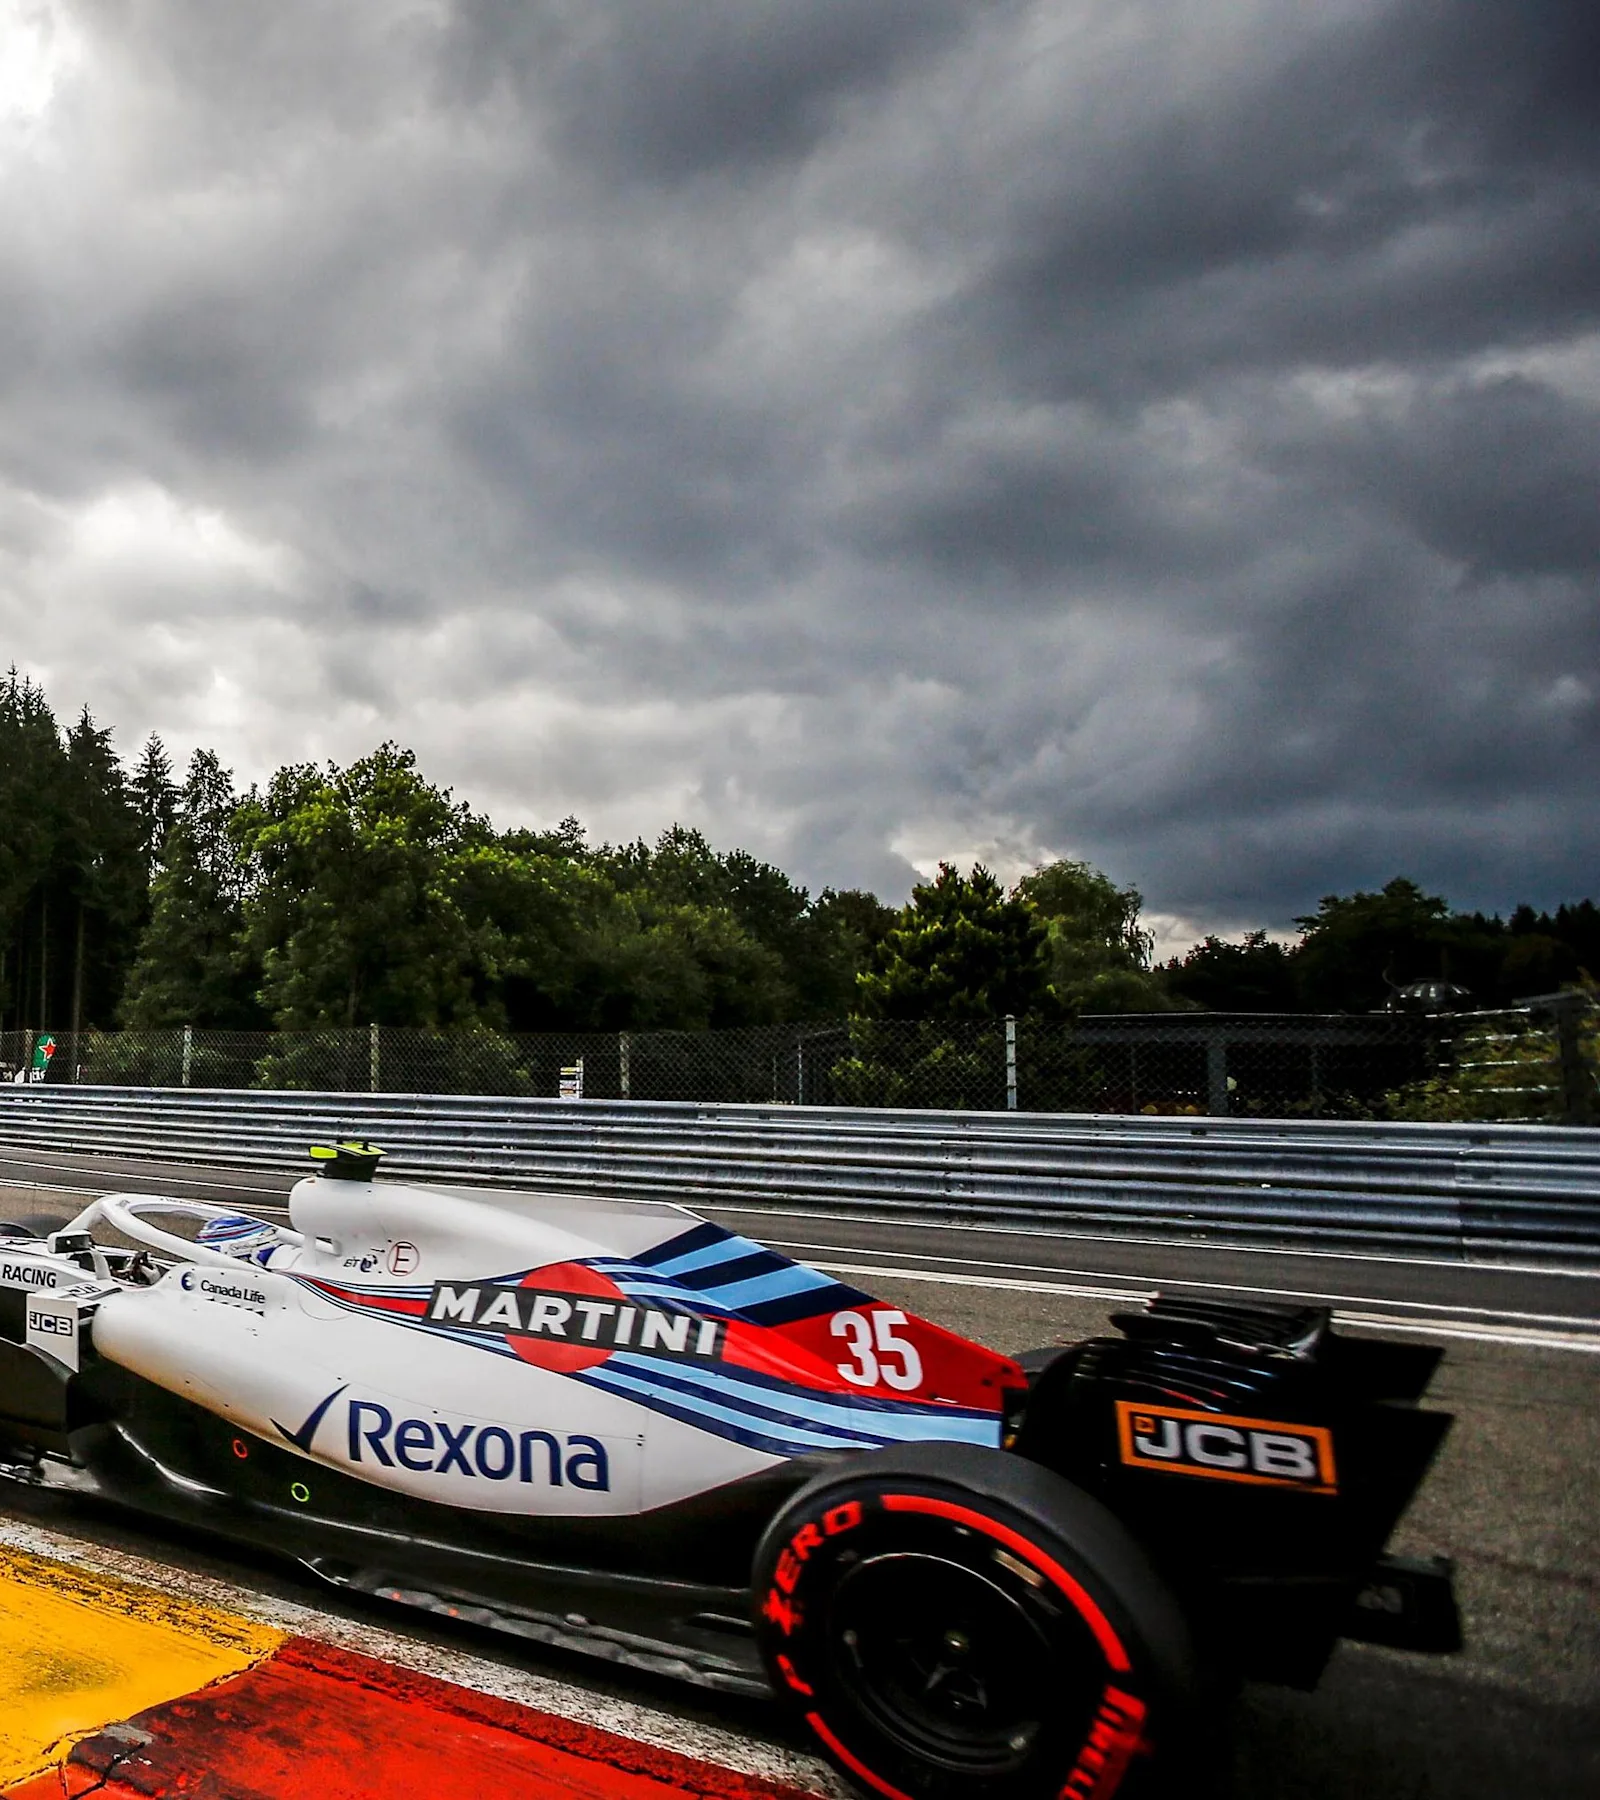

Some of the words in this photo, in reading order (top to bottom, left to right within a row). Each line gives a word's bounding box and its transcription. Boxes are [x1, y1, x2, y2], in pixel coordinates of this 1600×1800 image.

[2, 1264, 57, 1289] RACING
[392, 1245, 412, 1274] E
[200, 1279, 243, 1299] Canada
[244, 1288, 266, 1304] Life
[30, 1313, 72, 1336] JCB
[430, 1285, 719, 1356] MARTINI
[829, 1309, 924, 1391] 35
[348, 1399, 610, 1493] Rexona
[1134, 1418, 1317, 1479] JCB
